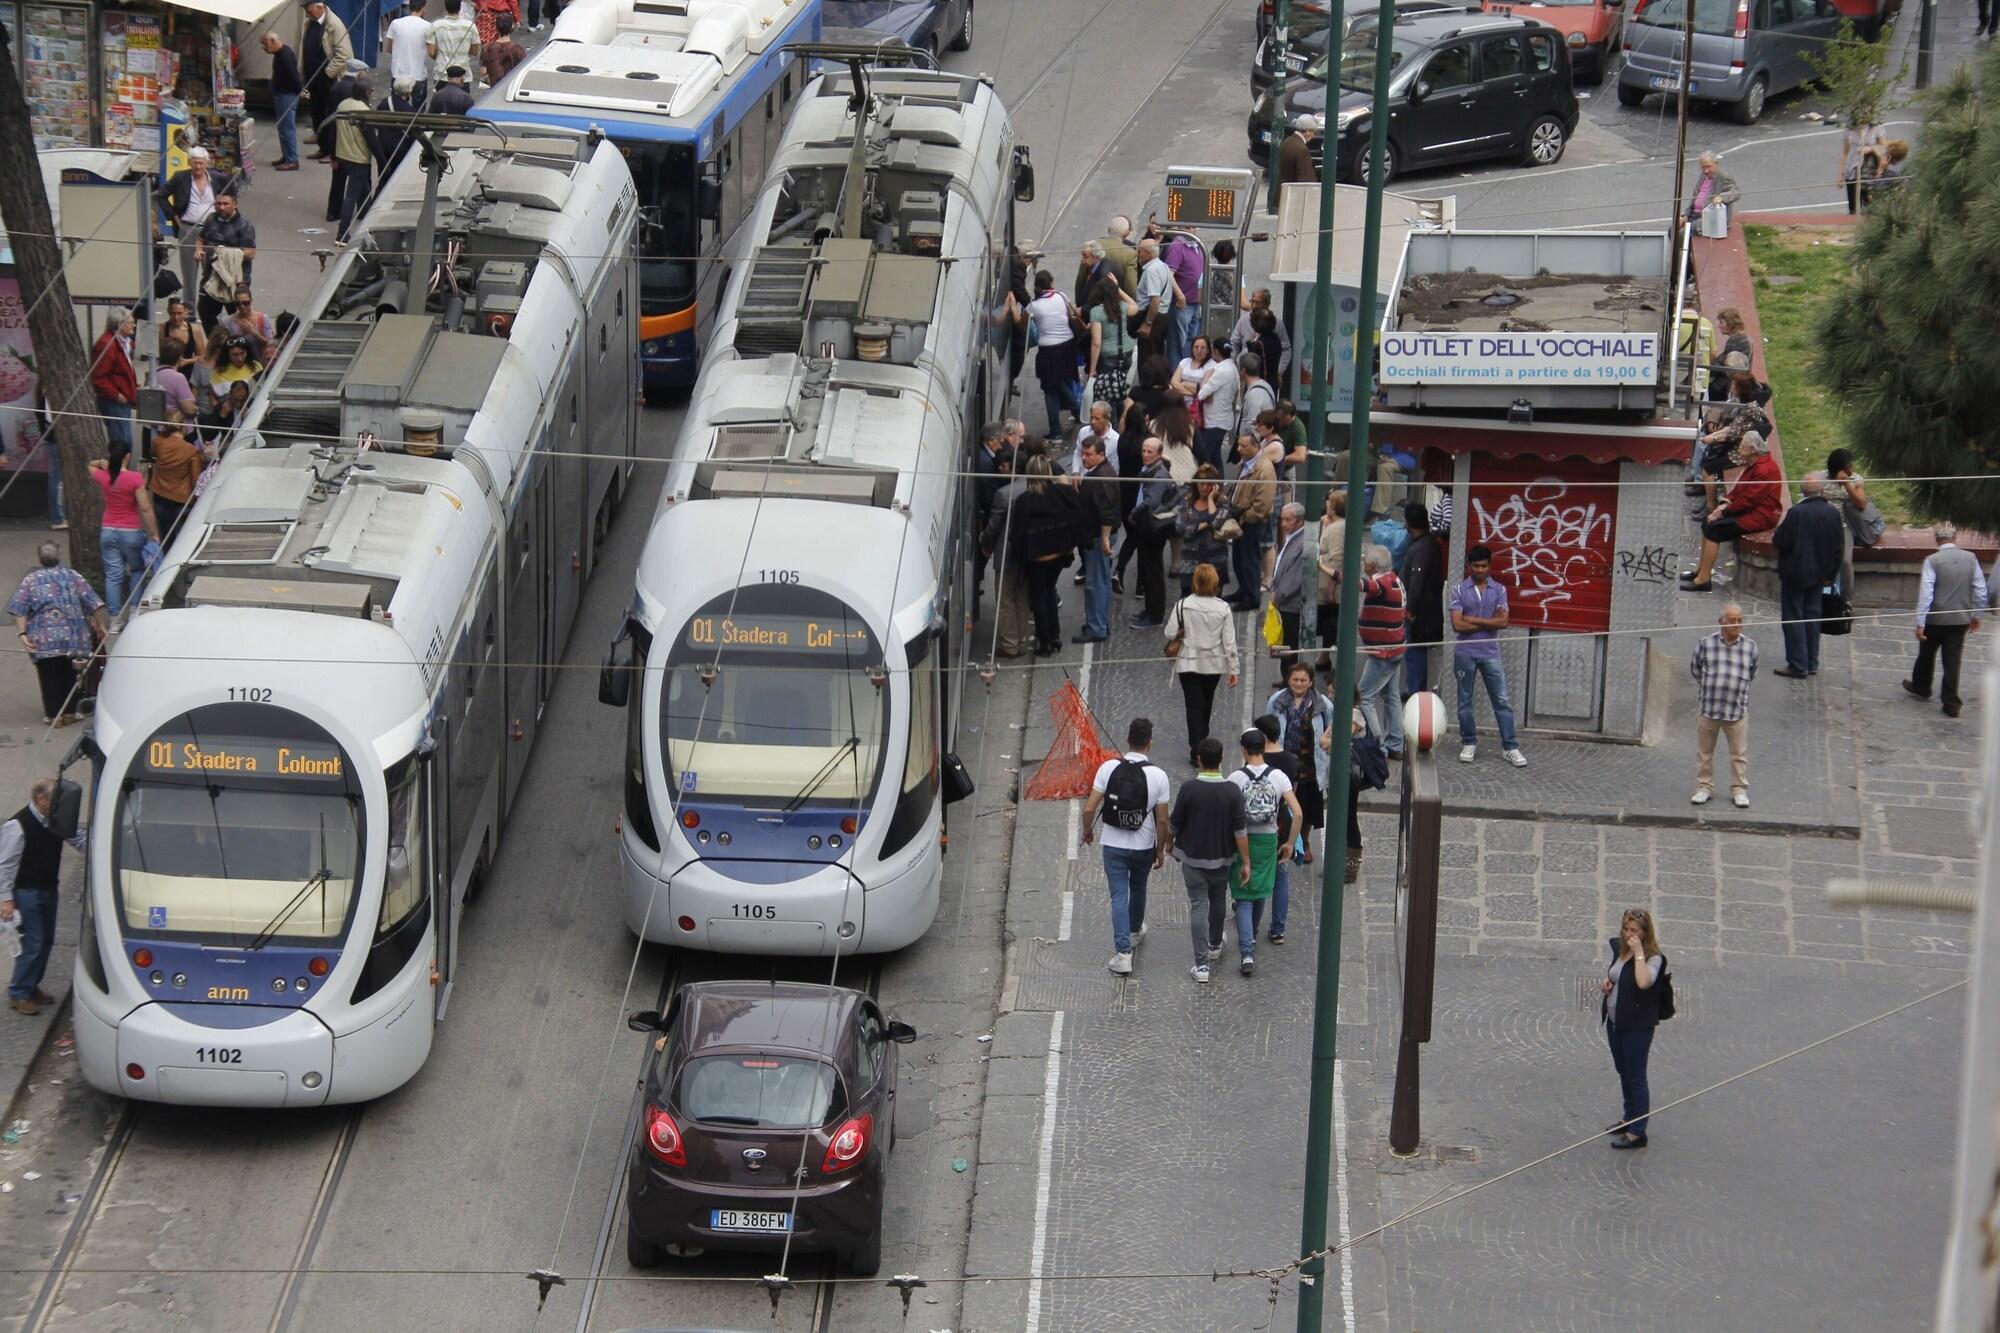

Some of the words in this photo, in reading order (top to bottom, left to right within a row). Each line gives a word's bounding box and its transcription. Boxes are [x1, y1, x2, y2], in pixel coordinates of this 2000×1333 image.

[1168, 176, 1188, 185] anm
[1384, 338, 1473, 356] OUTLET
[1480, 338, 1654, 357] DELL'OCCHIALE
[1387, 366, 1446, 377] Occhiali
[1451, 366, 1500, 377] firmati
[1505, 369, 1513, 377] a
[1518, 367, 1568, 379] partire
[1573, 366, 1591, 377] da
[1596, 366, 1637, 379] 19,00
[1642, 367, 1651, 378] €
[759, 569, 800, 584] 1105
[692, 618, 715, 643] 01
[721, 620, 788, 645] Stadera
[227, 687, 273, 703] 1102
[150, 741, 175, 768] 01
[183, 743, 257, 771] Stadera
[732, 904, 776, 919] 1105
[207, 985, 249, 1000] anm
[195, 1047, 242, 1063] 1102
[720, 1211, 737, 1226] ED
[742, 1212, 785, 1228] 386FW
